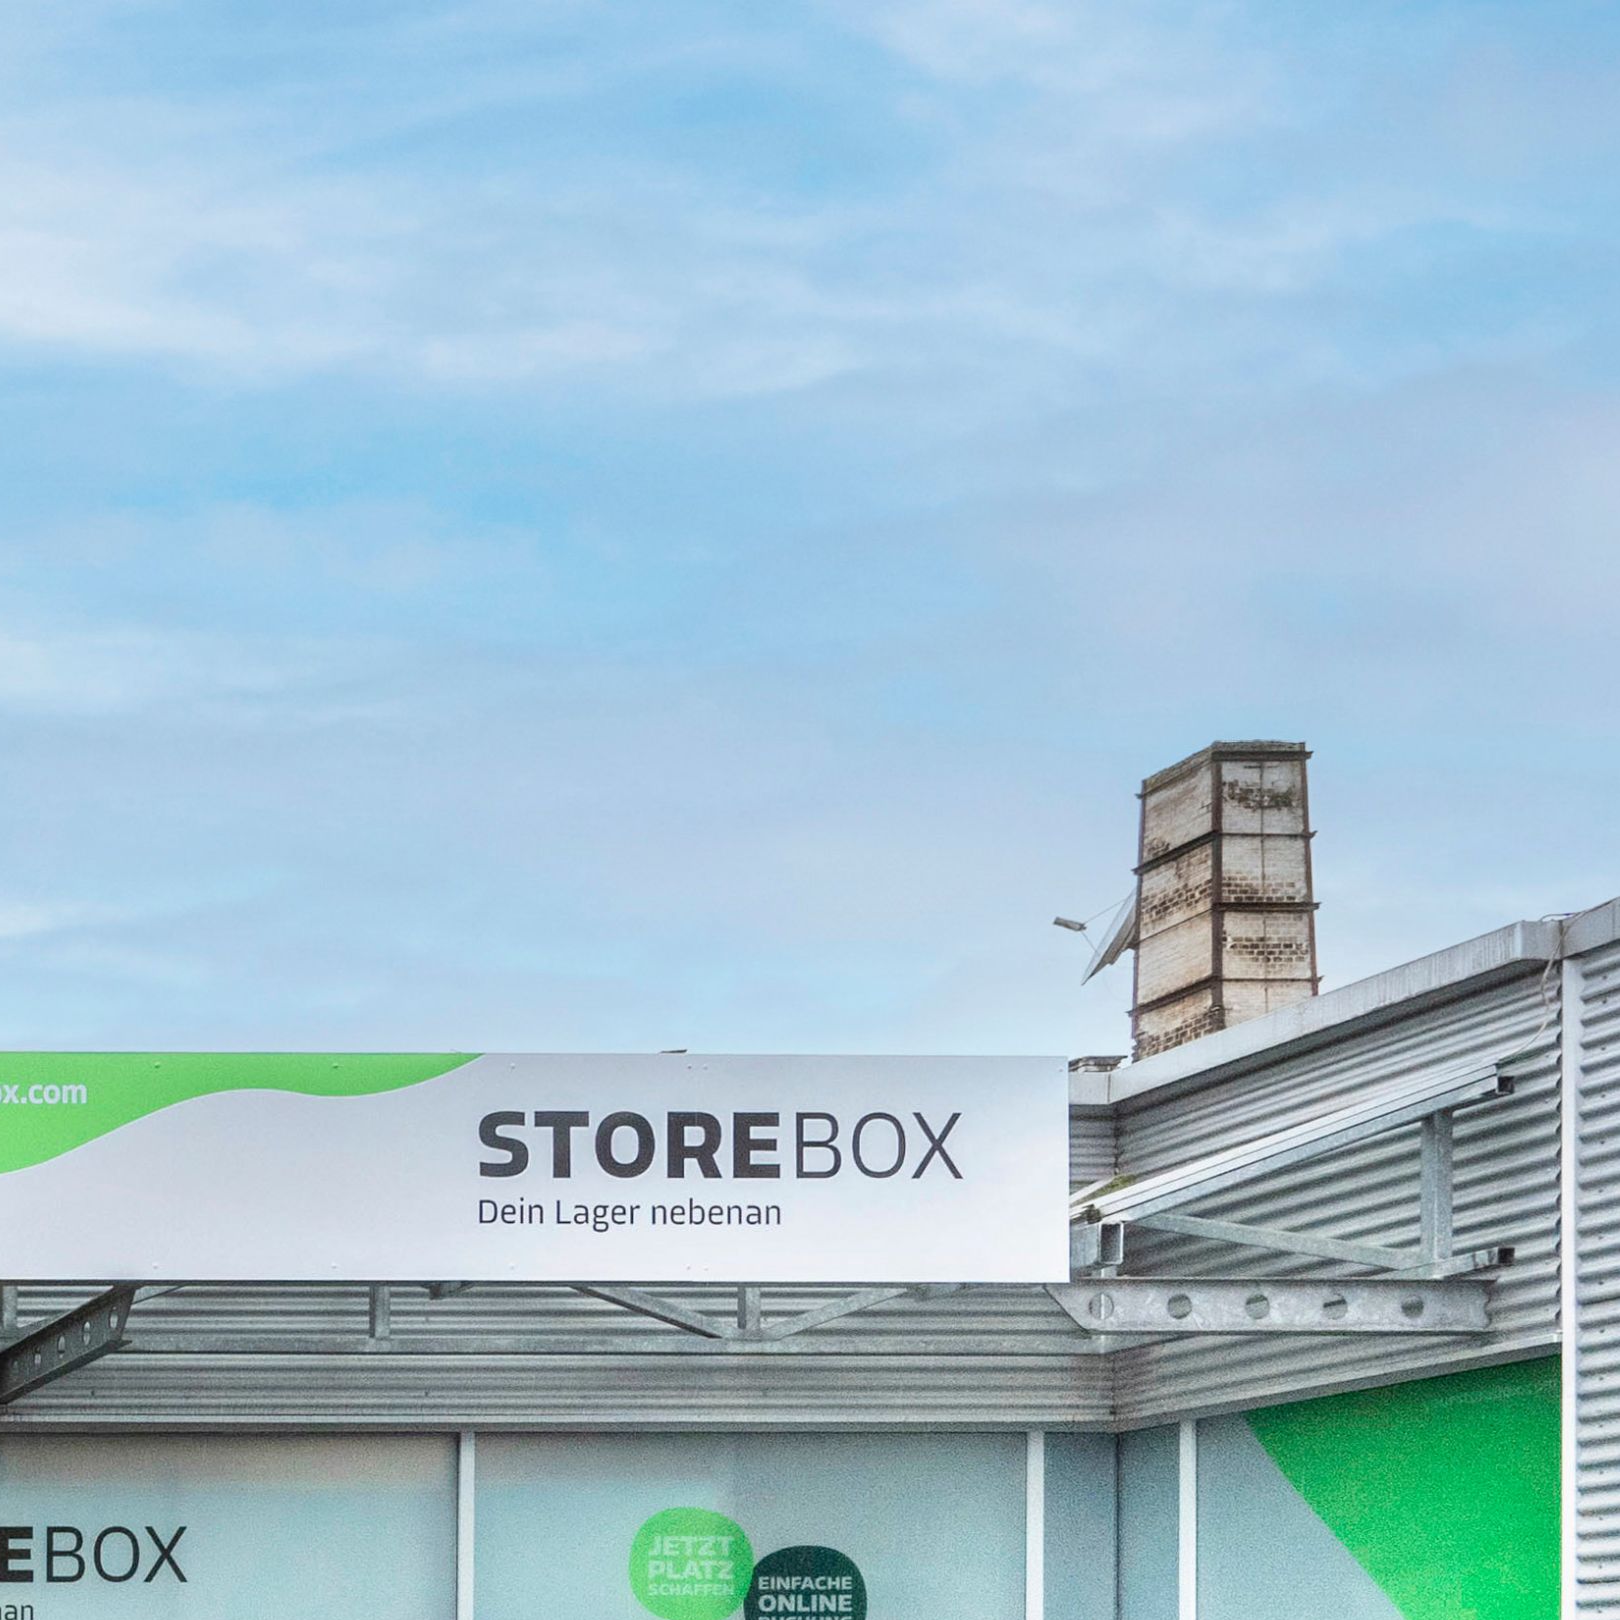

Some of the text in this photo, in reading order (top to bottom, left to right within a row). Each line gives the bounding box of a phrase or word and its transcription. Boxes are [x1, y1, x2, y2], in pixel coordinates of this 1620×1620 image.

[478, 1110, 964, 1179] STOREBOX
[478, 1197, 781, 1233] Dein Lager nebenan
[648, 1535, 735, 1556] JETZT
[647, 1560, 735, 1580] PLATZ
[648, 1583, 735, 1596] SCHAFFEN
[758, 1576, 853, 1590] EINFACHE
[758, 1594, 853, 1612] ONLINE
